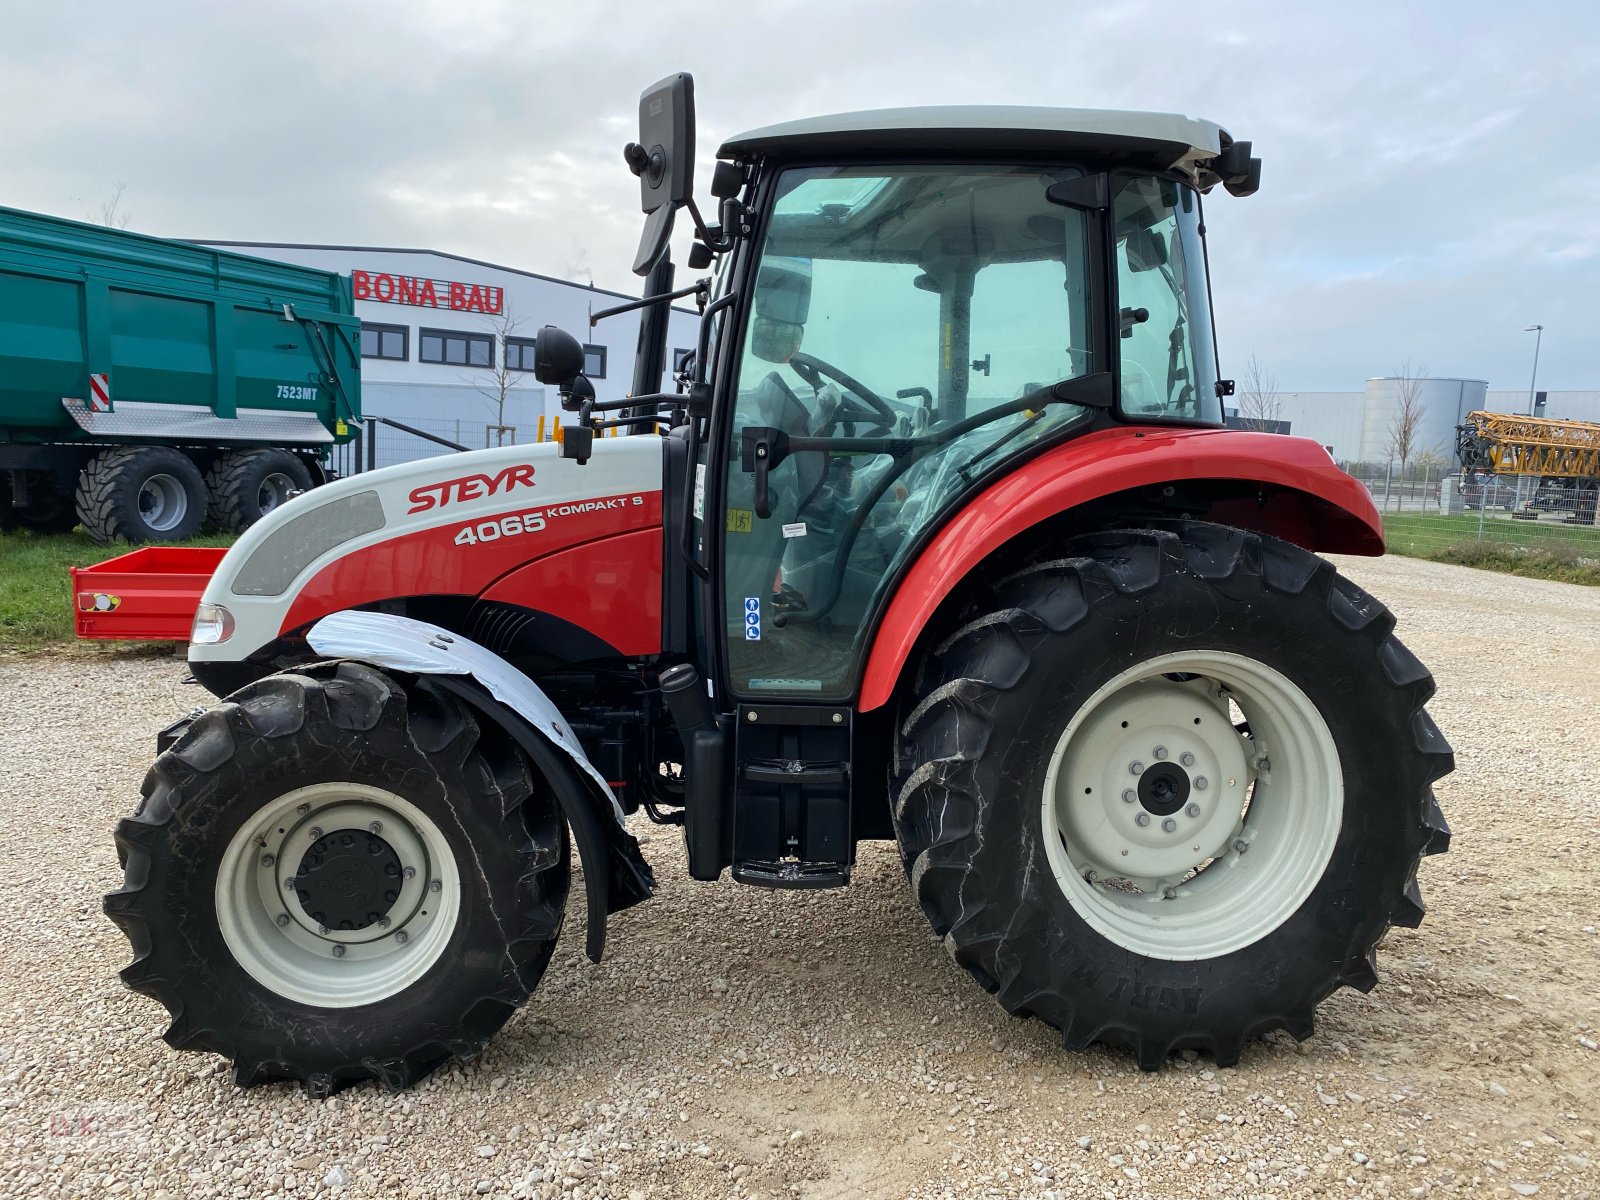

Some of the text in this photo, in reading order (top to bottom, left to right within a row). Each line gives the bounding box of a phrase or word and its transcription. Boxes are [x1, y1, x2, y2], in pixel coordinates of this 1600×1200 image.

[354, 271, 502, 314] BONA-BAU
[277, 385, 318, 401] 7523MT
[407, 464, 537, 515] STEYR
[454, 496, 644, 546] 4065 KOMPAKT S
